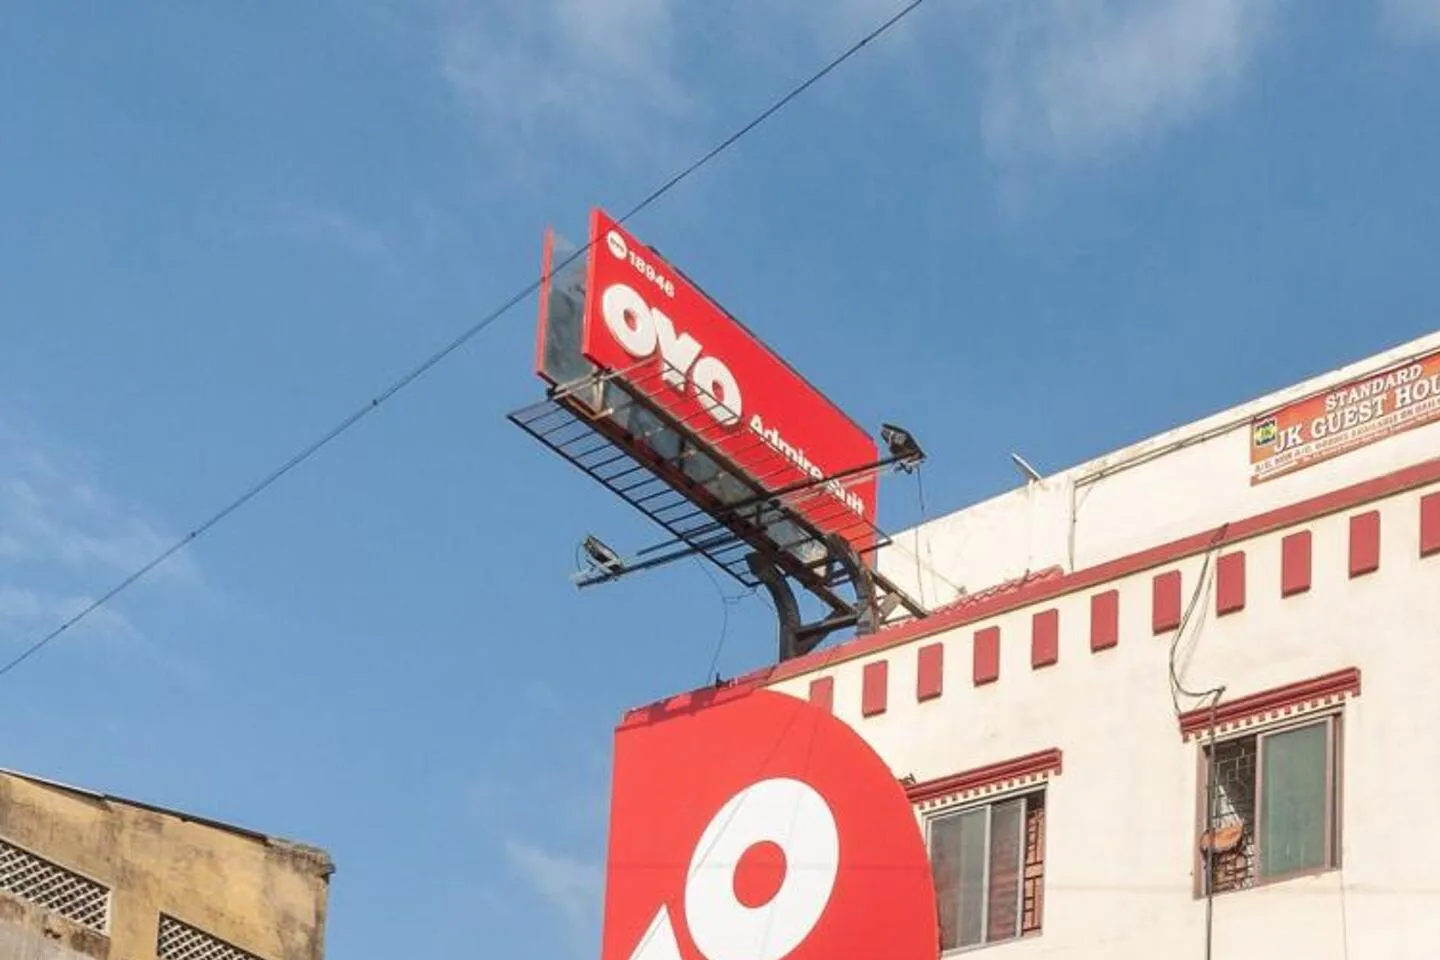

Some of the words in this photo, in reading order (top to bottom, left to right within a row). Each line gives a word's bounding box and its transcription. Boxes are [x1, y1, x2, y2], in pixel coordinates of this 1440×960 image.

[603, 283, 742, 427] OYO
[1325, 364, 1423, 410] STANDARD
[1274, 425, 1303, 453] JK
[1311, 395, 1389, 438] GUEST
